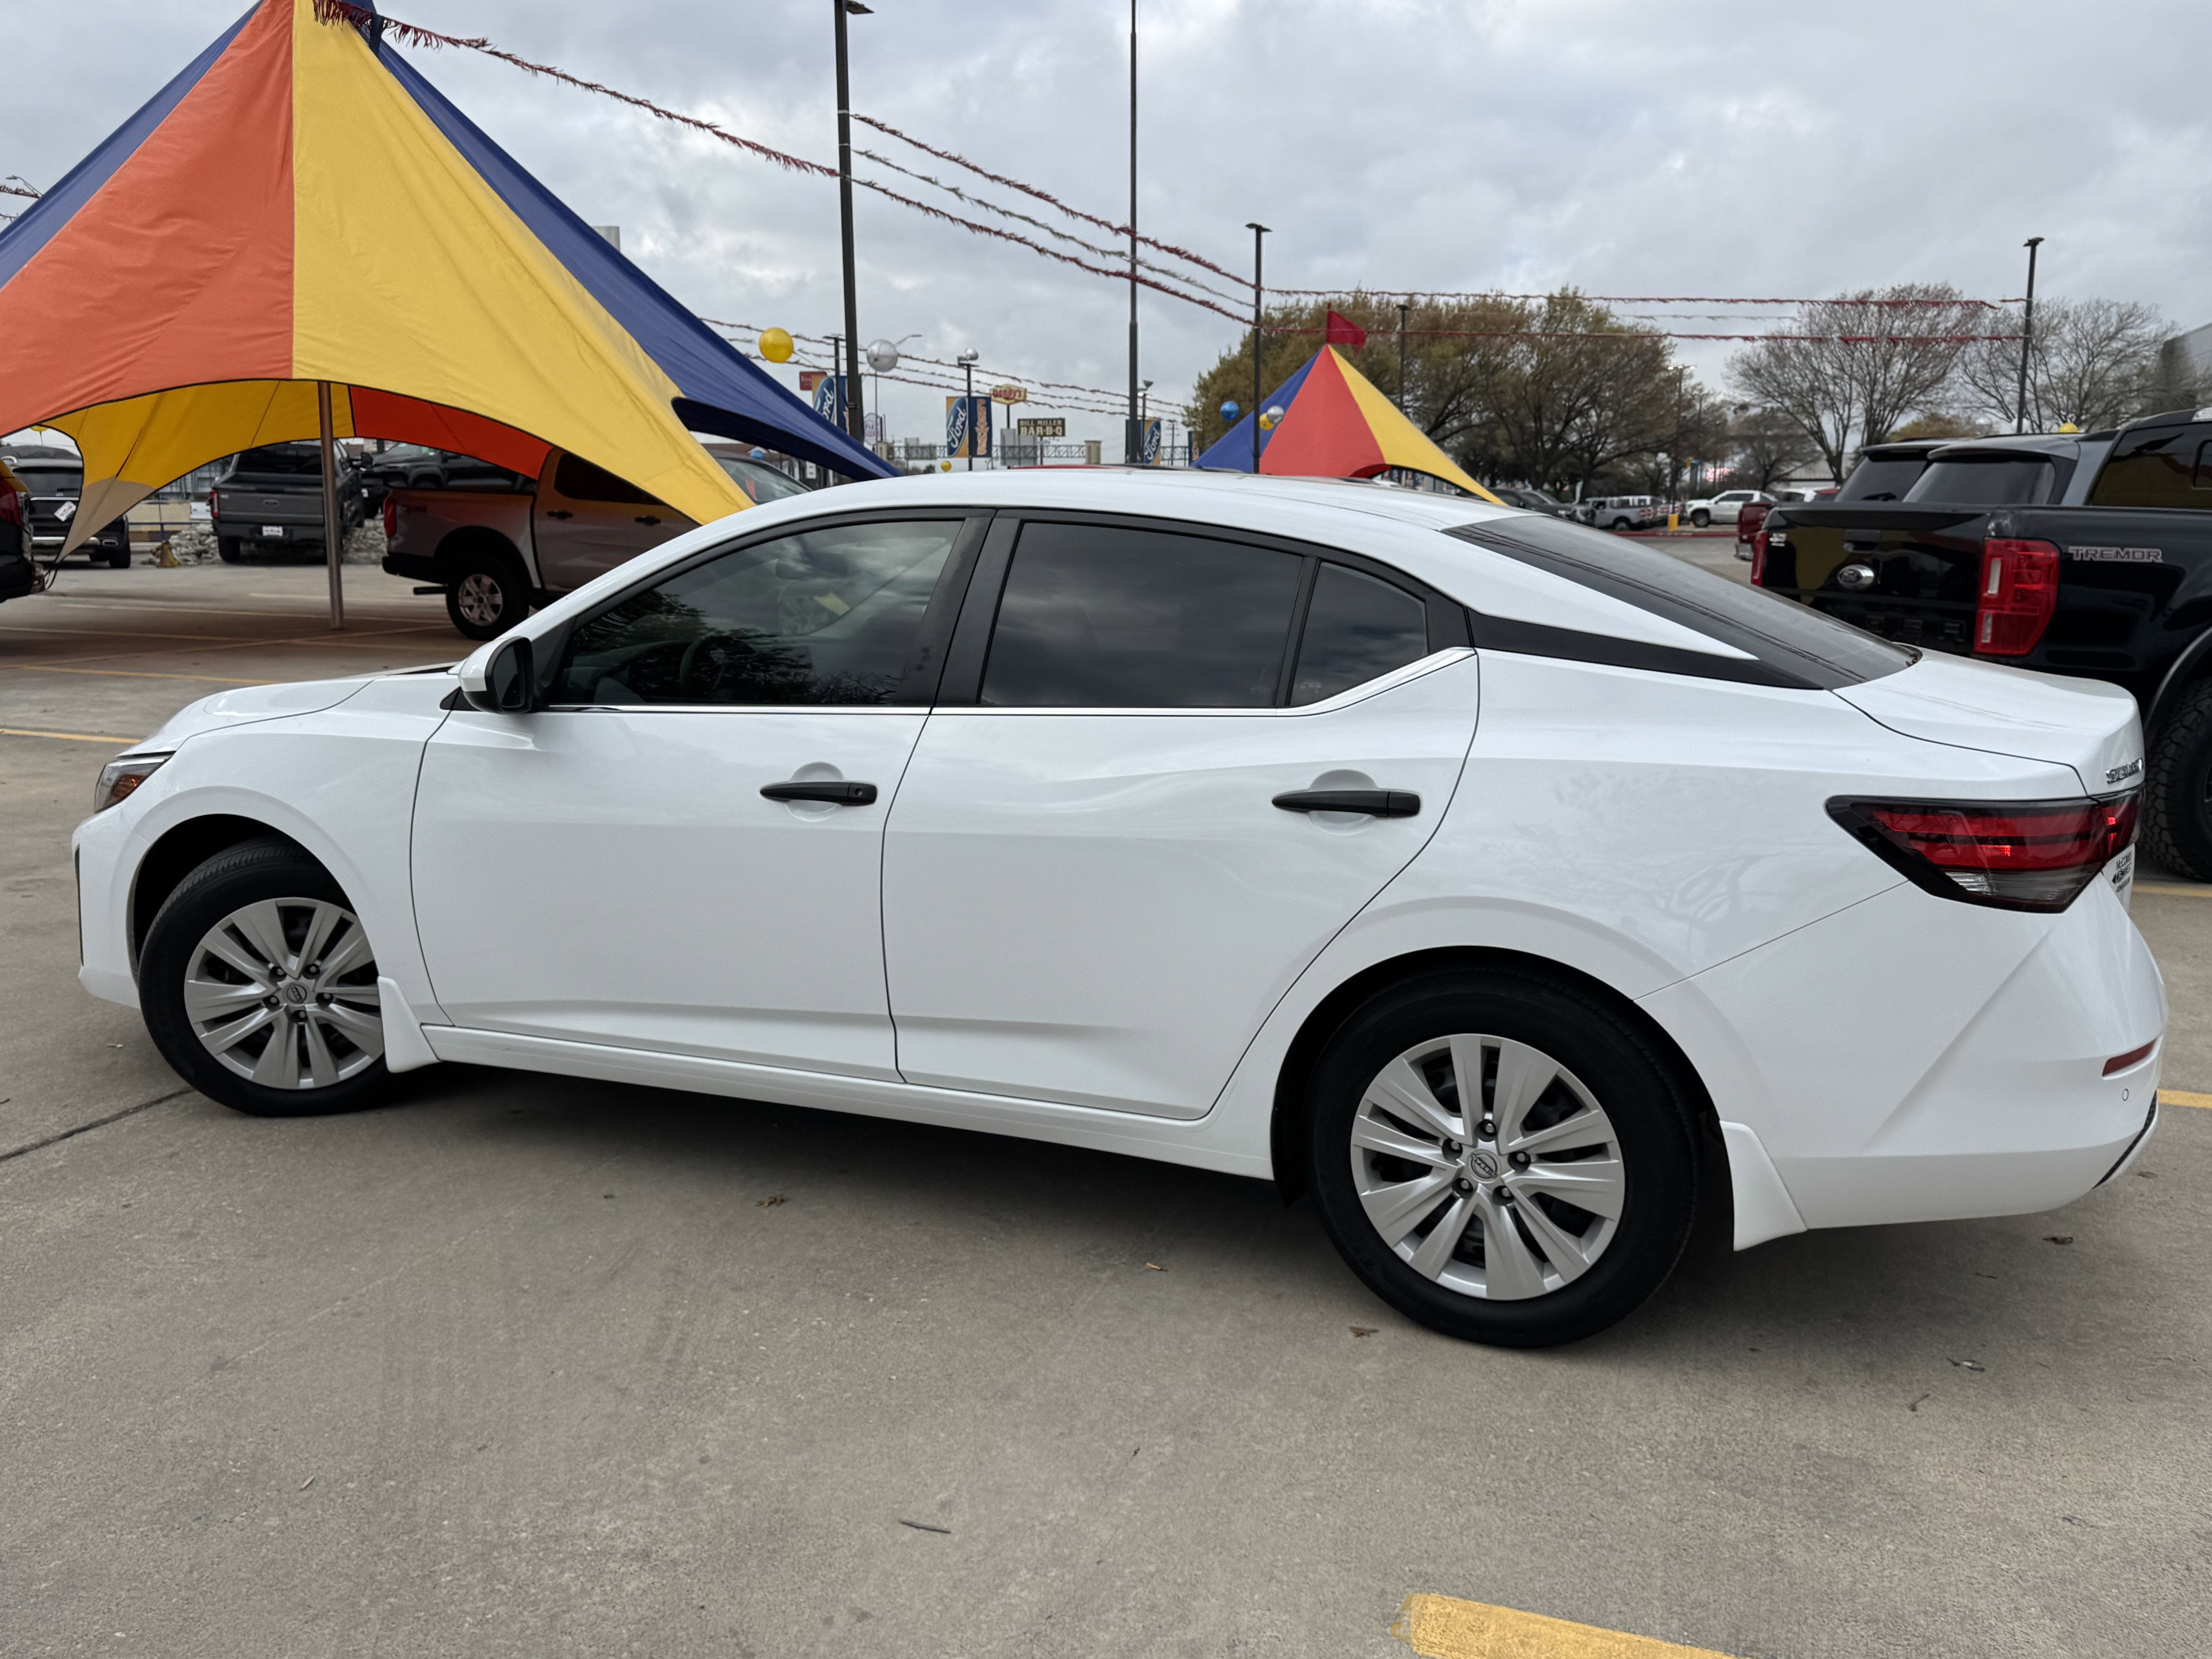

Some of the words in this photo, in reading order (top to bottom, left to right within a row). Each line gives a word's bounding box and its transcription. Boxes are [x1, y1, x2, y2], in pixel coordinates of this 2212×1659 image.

[947, 406, 966, 448] Ford
[1144, 427, 1160, 460] Ford
[2068, 545, 2163, 563] TREMOR
